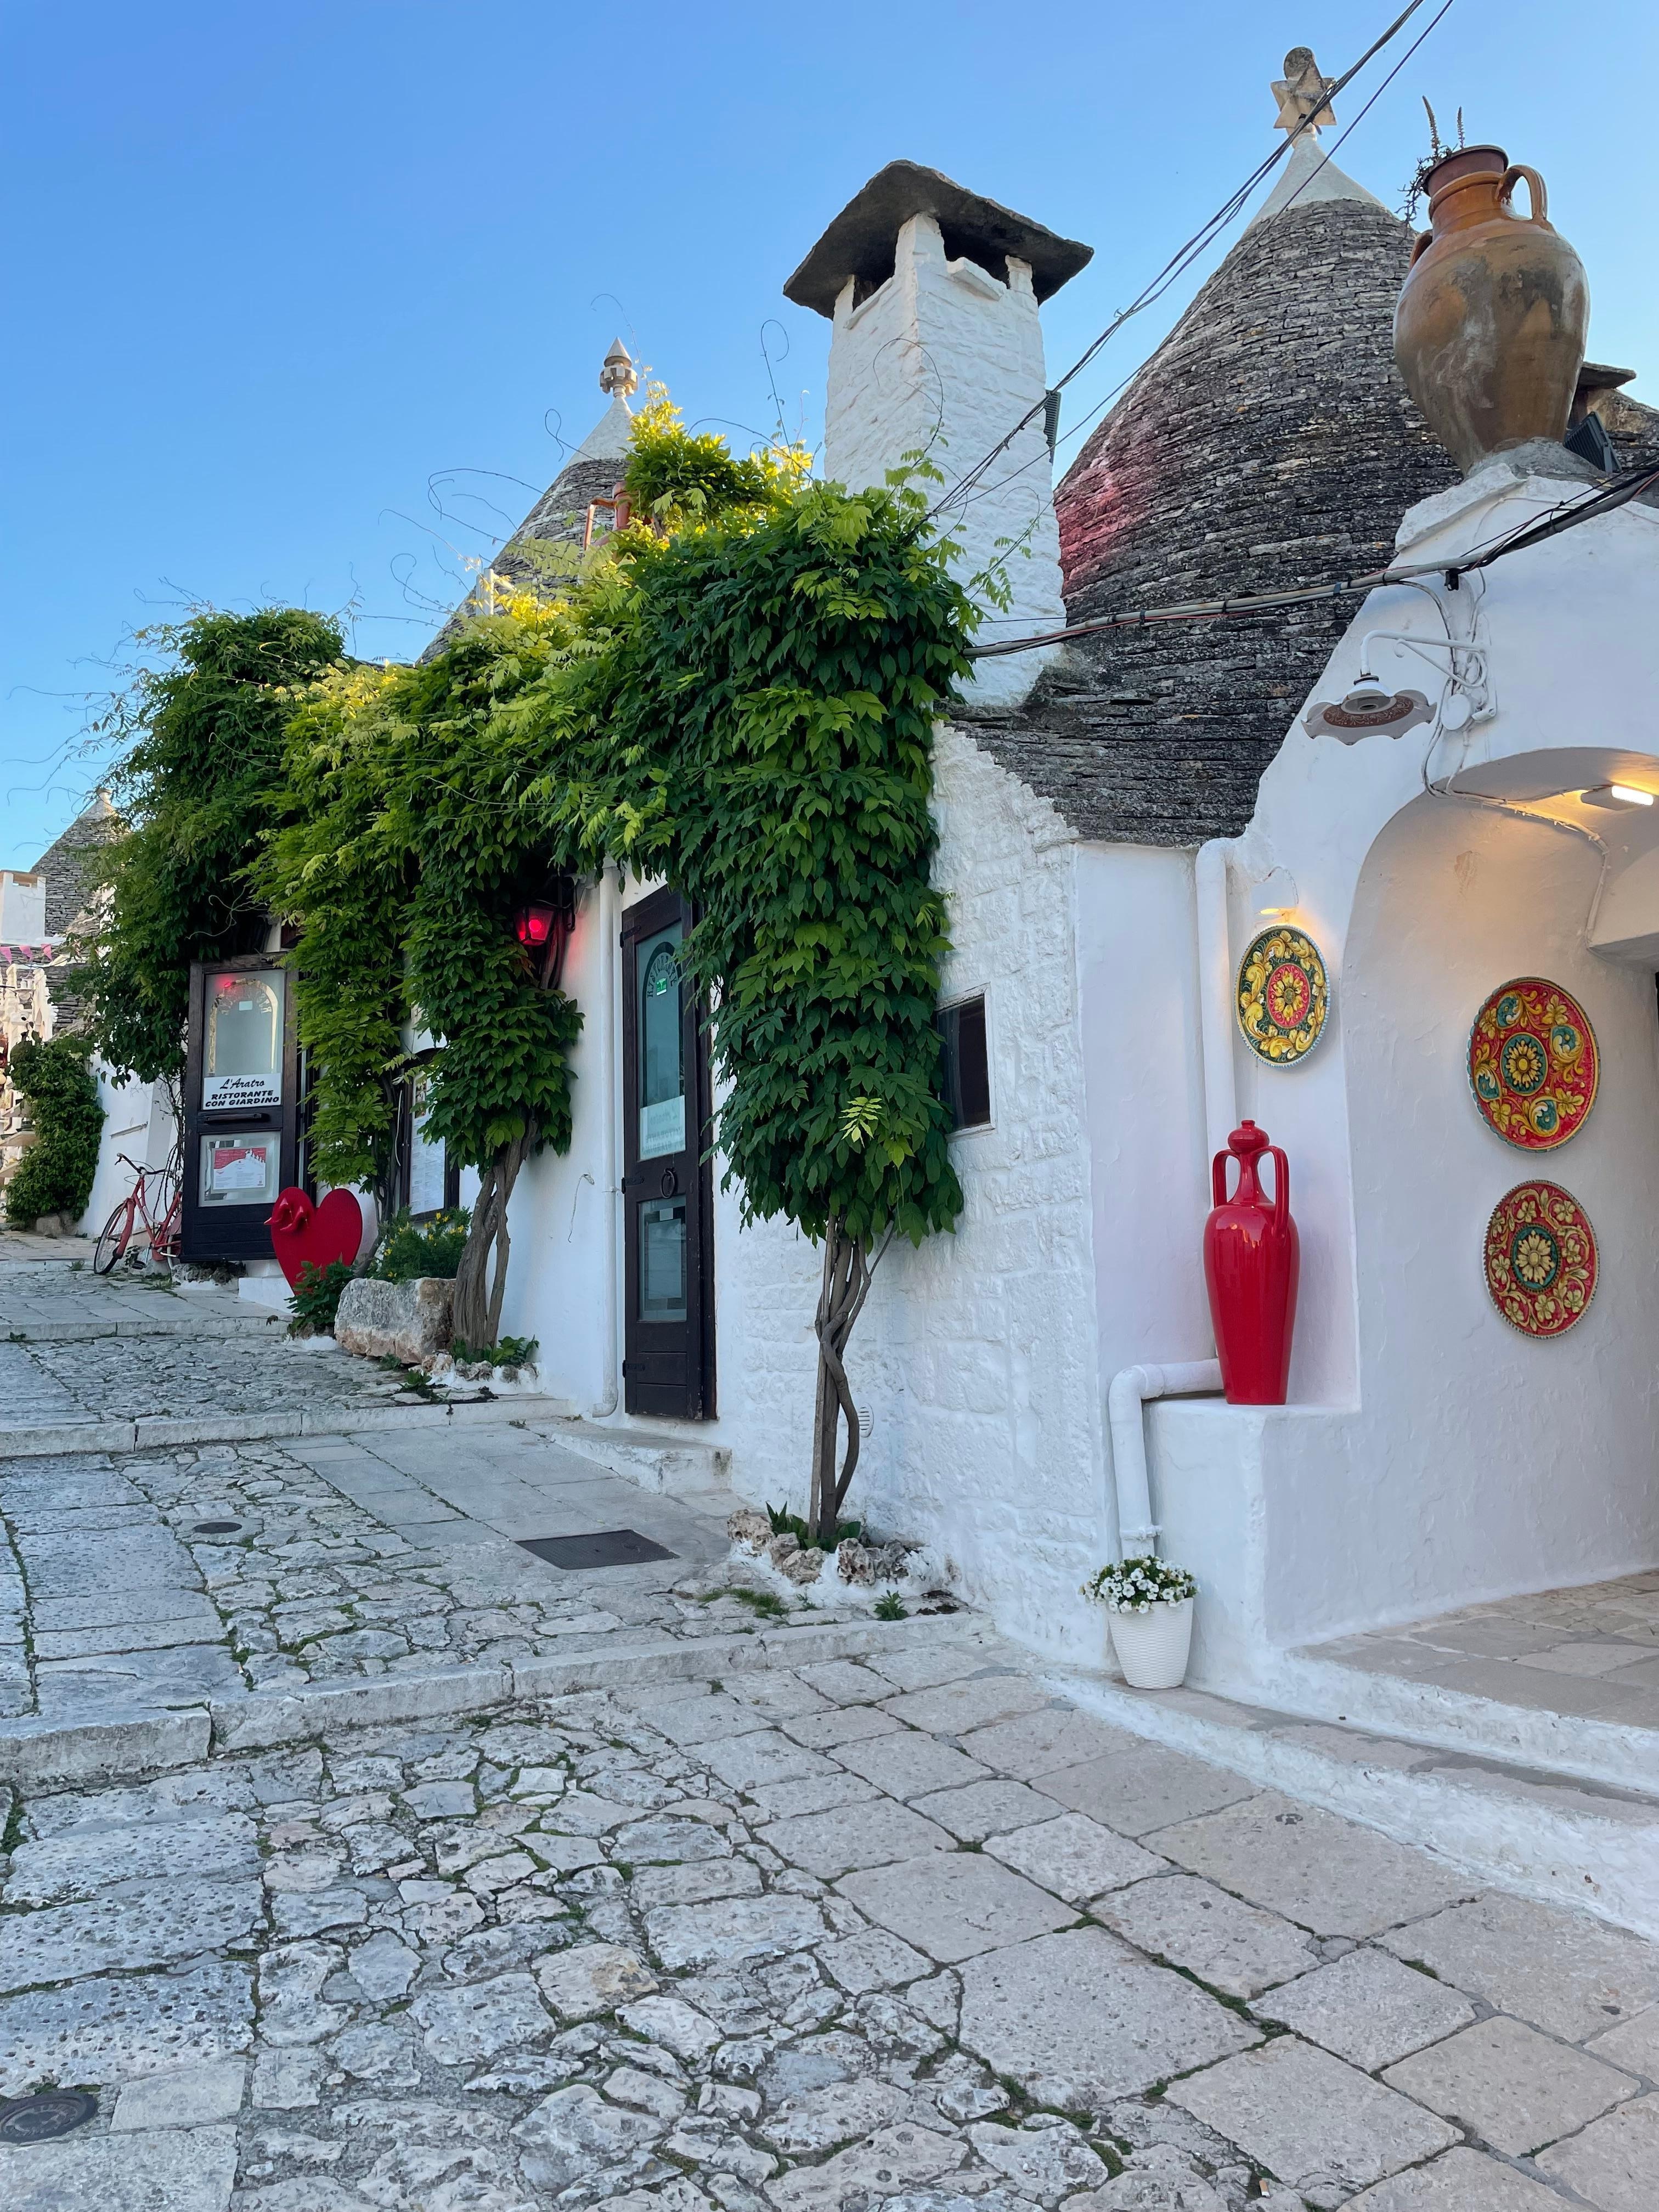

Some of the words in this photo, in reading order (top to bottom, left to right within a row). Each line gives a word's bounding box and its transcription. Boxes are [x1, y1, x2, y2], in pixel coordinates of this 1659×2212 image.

[219, 1077, 264, 1089] L'Aratro
[211, 1090, 274, 1099] RISTORANTE
[229, 1097, 279, 1105] GIARDINO
